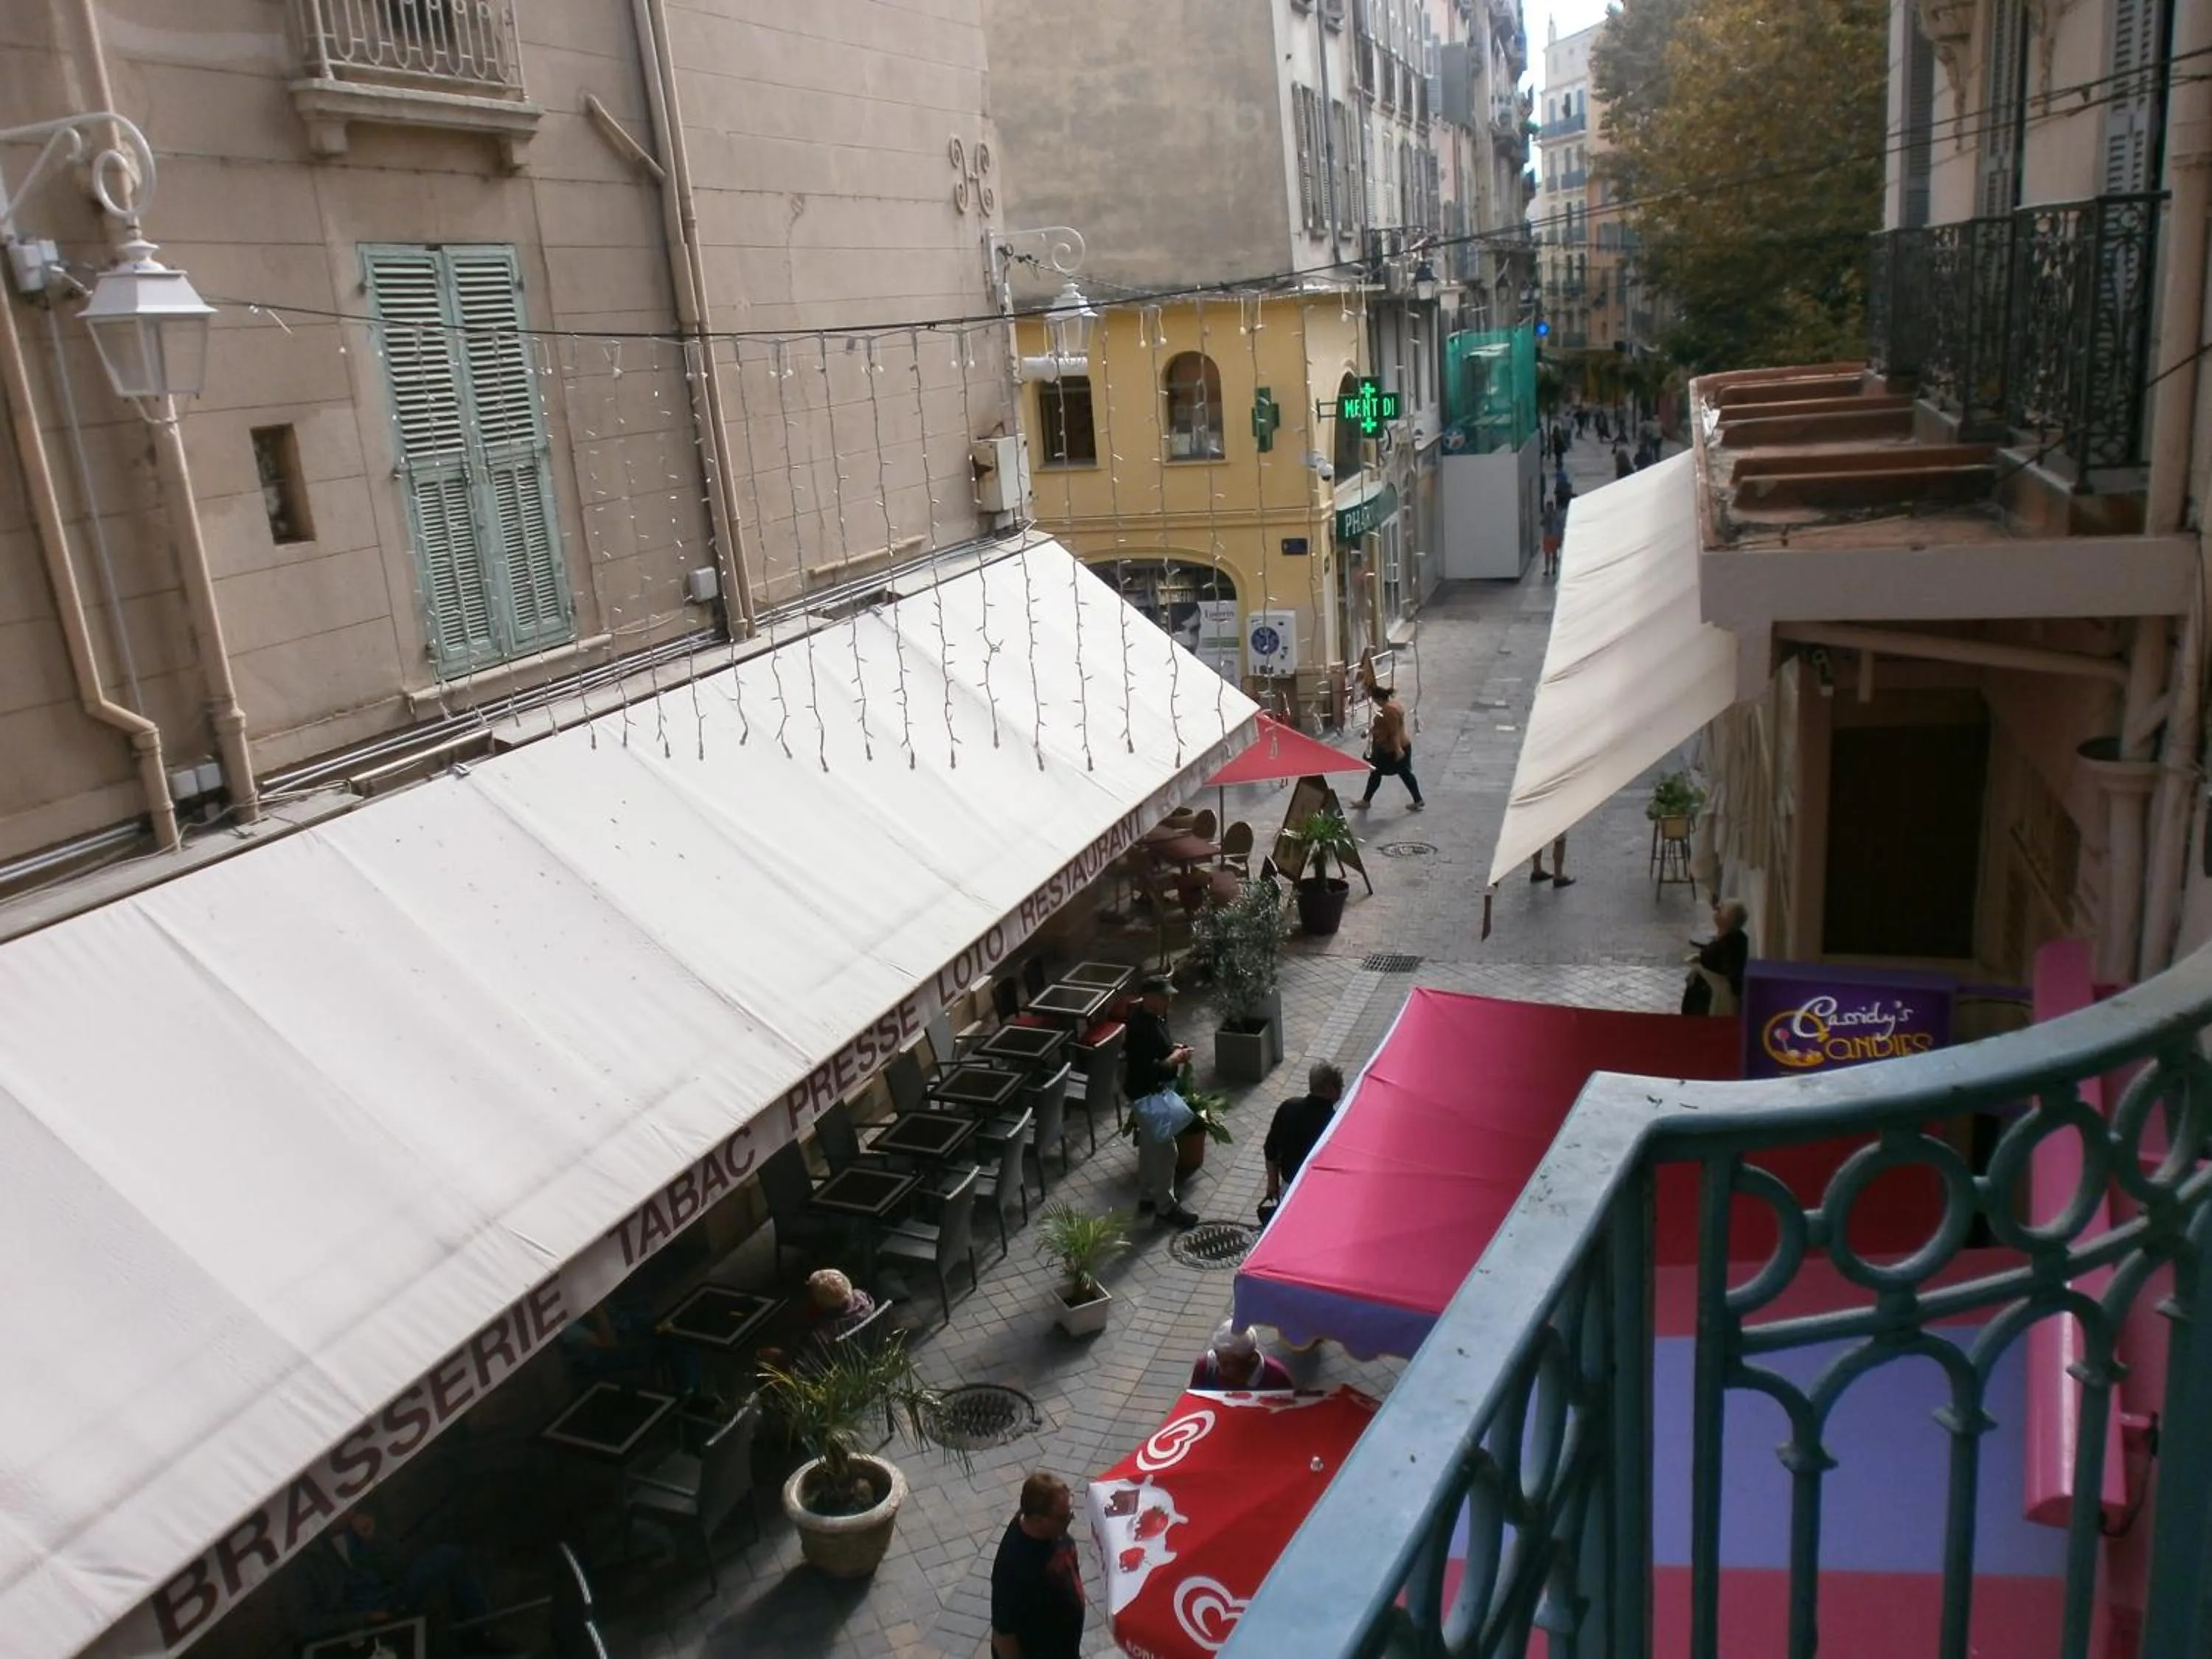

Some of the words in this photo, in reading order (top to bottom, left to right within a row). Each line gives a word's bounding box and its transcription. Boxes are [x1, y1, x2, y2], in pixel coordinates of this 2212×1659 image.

[150, 1274, 568, 1649] BRASSERIE
[608, 1126, 757, 1267] TABAC
[785, 998, 921, 1131] PRESSE
[936, 925, 1005, 1007] LOTO
[1019, 803, 1144, 935] RESTAURANT
[1792, 995, 1914, 1041] Cassidy's
